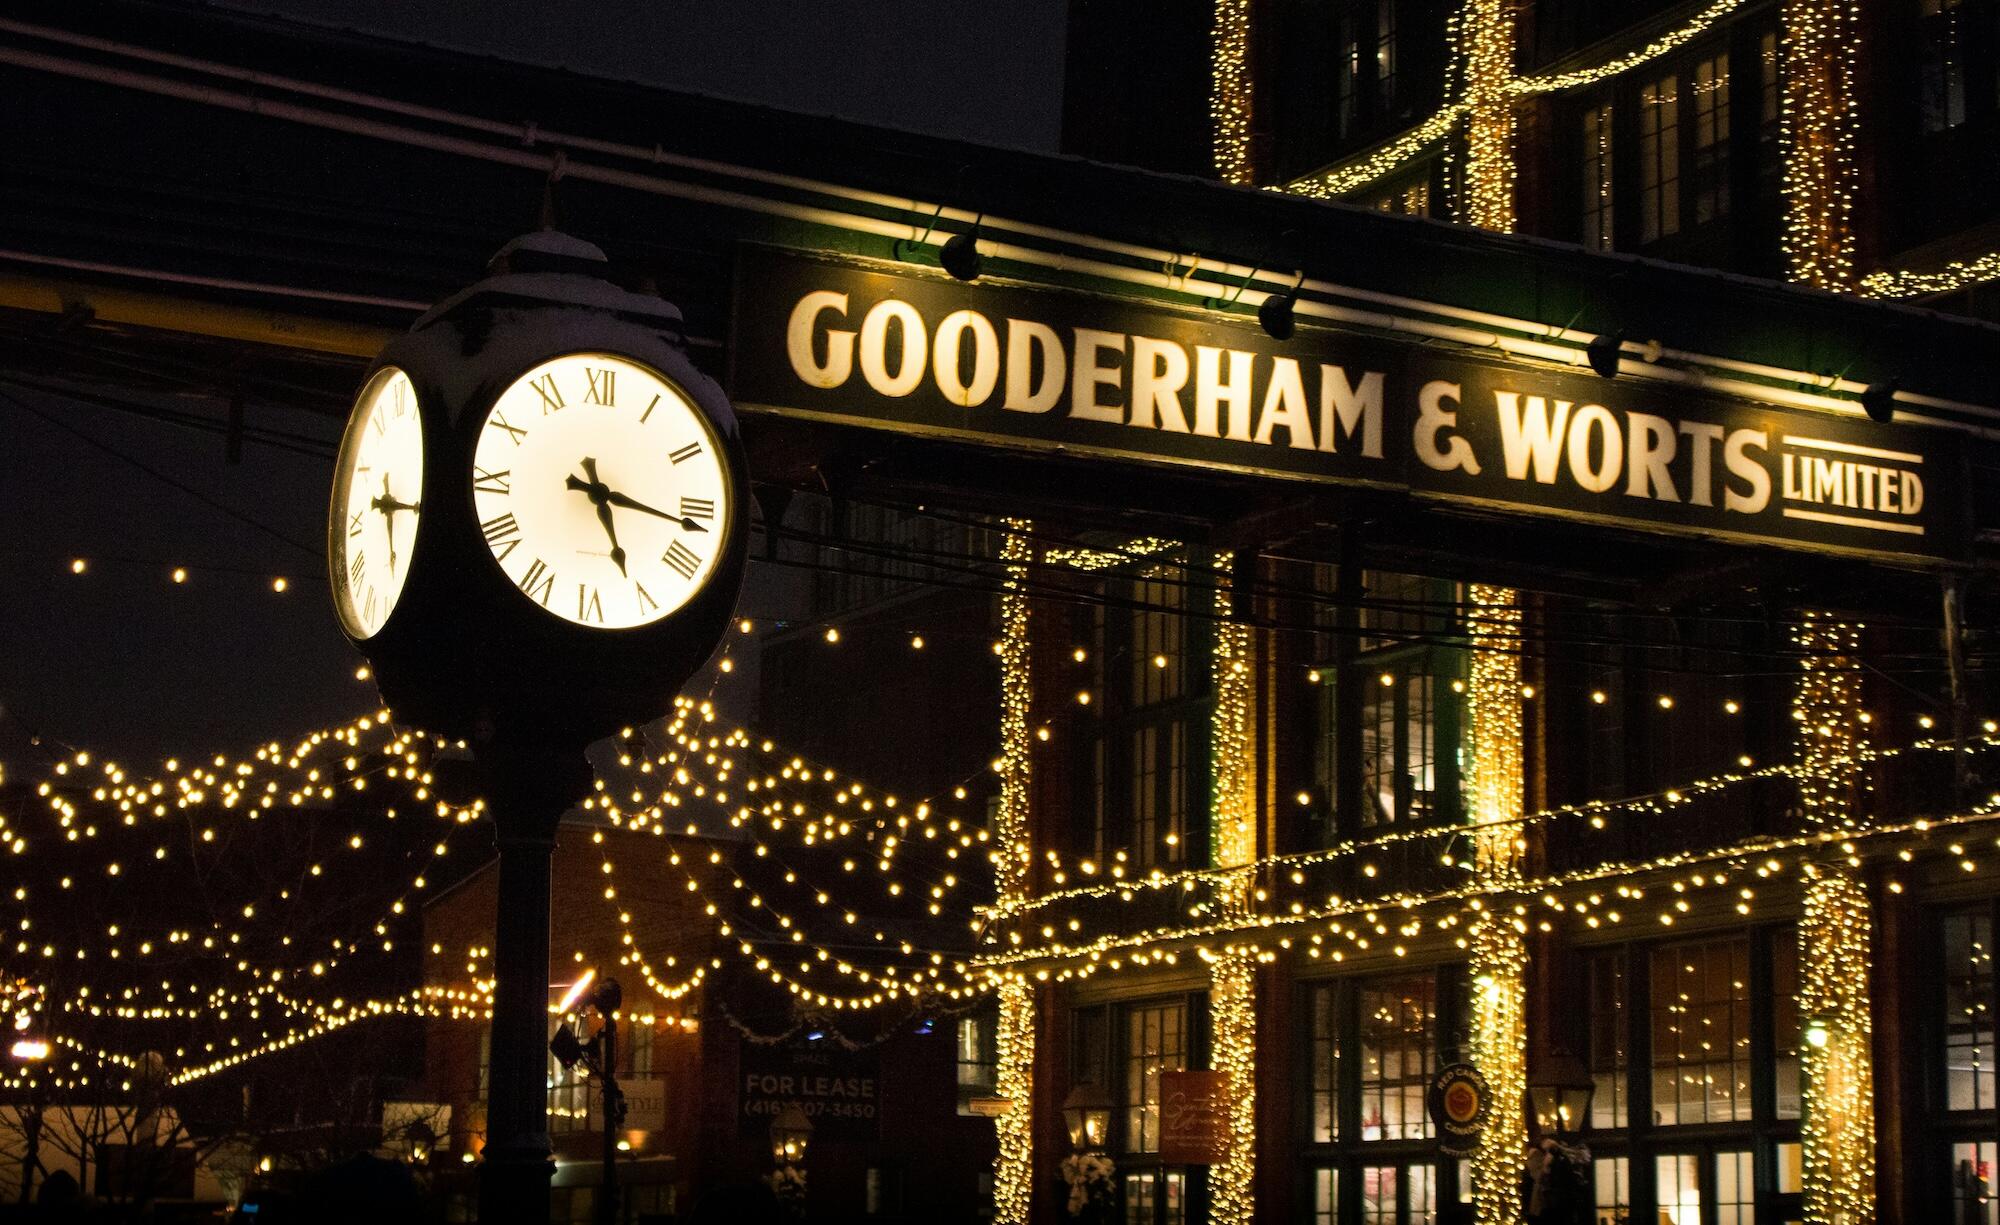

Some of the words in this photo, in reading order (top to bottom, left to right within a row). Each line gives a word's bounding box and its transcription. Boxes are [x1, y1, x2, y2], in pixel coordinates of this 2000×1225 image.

[529, 373, 567, 416] XI
[584, 367, 616, 407] XII
[786, 289, 1386, 459] GOODERHAM
[1412, 380, 1482, 476] &
[1493, 390, 1772, 515] WORTS
[489, 410, 528, 446] X
[639, 393, 661, 425] I
[668, 441, 702, 465] II
[473, 465, 511, 496] IX
[1782, 452, 1925, 516] LIMITED
[680, 496, 714, 520] III
[480, 512, 523, 562] VIII
[661, 539, 703, 581] IIII
[518, 557, 556, 607] VII
[634, 578, 660, 617] V
[577, 583, 604, 623] VI
[746, 1073, 795, 1095] FOR
[800, 1076, 875, 1098] LEASE
